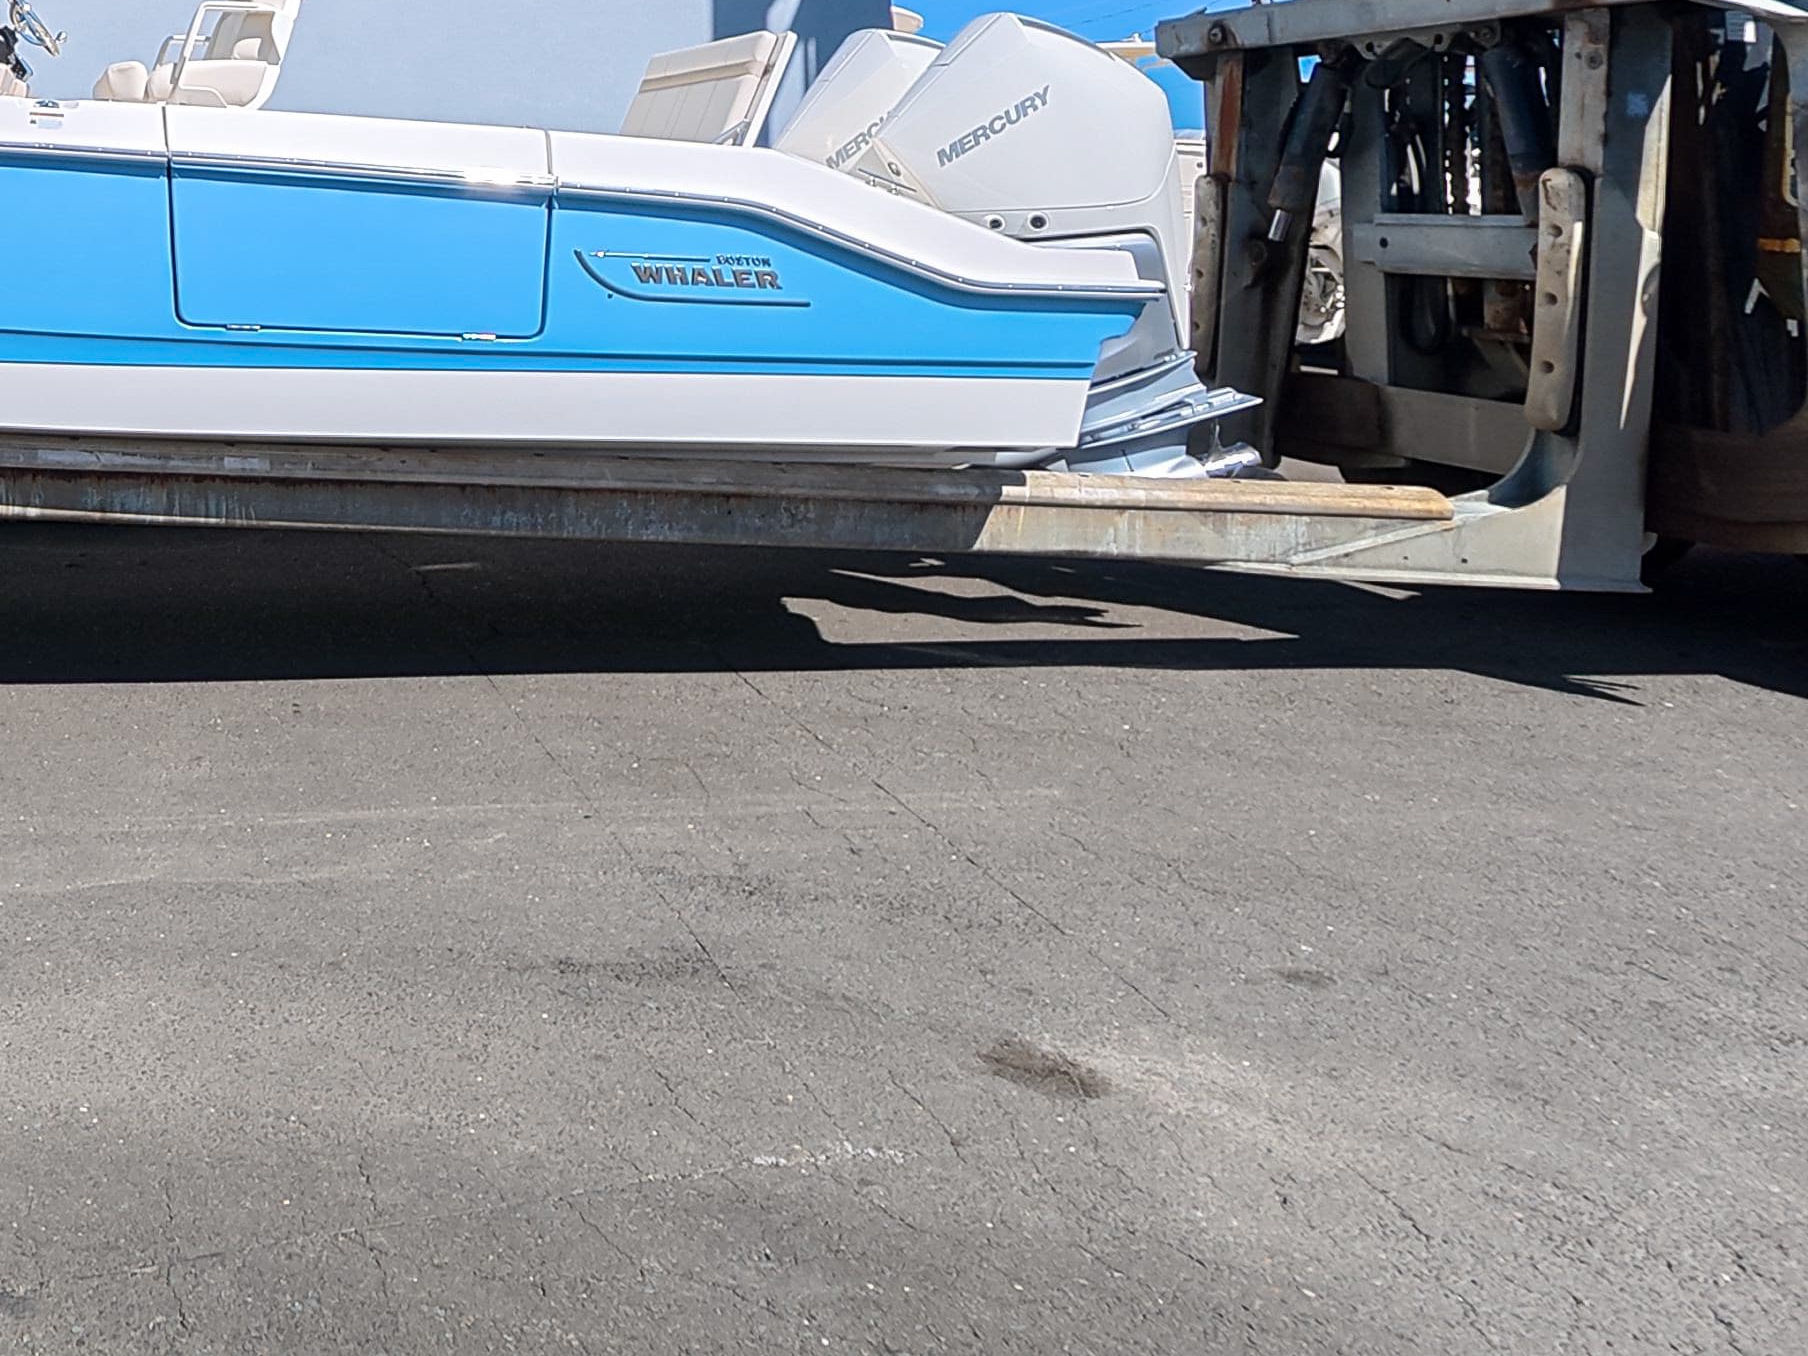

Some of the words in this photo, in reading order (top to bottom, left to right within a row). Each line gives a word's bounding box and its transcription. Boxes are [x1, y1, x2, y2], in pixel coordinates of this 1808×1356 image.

[825, 115, 884, 169] MERC
[937, 84, 1049, 167] MERCURY
[631, 264, 783, 290] WHALER
[715, 254, 772, 267] BOSTON
